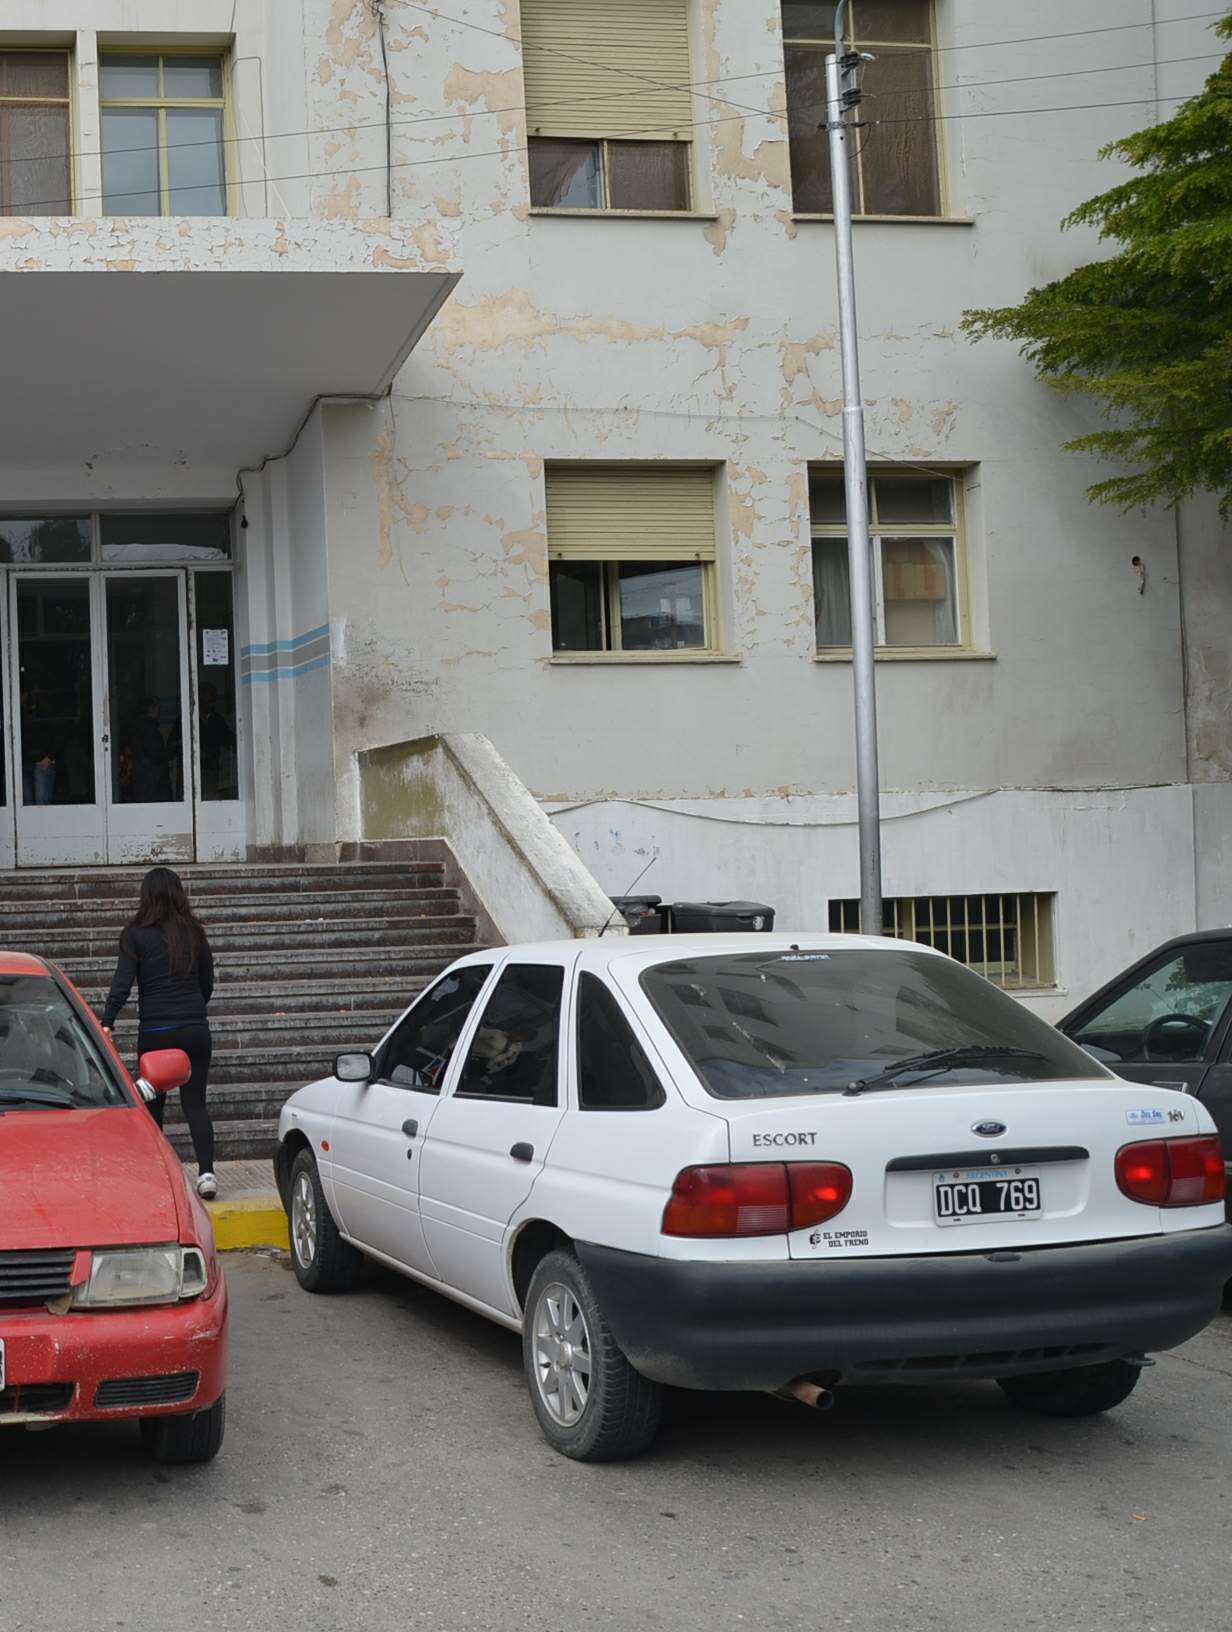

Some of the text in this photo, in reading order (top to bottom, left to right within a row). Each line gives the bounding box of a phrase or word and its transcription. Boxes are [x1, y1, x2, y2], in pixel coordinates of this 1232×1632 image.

[752, 1132, 818, 1147] ESCORT
[938, 1180, 1038, 1215] DCQ 769
[823, 1230, 868, 1240] EL EMPORIO
[828, 1240, 843, 1248] DEL
